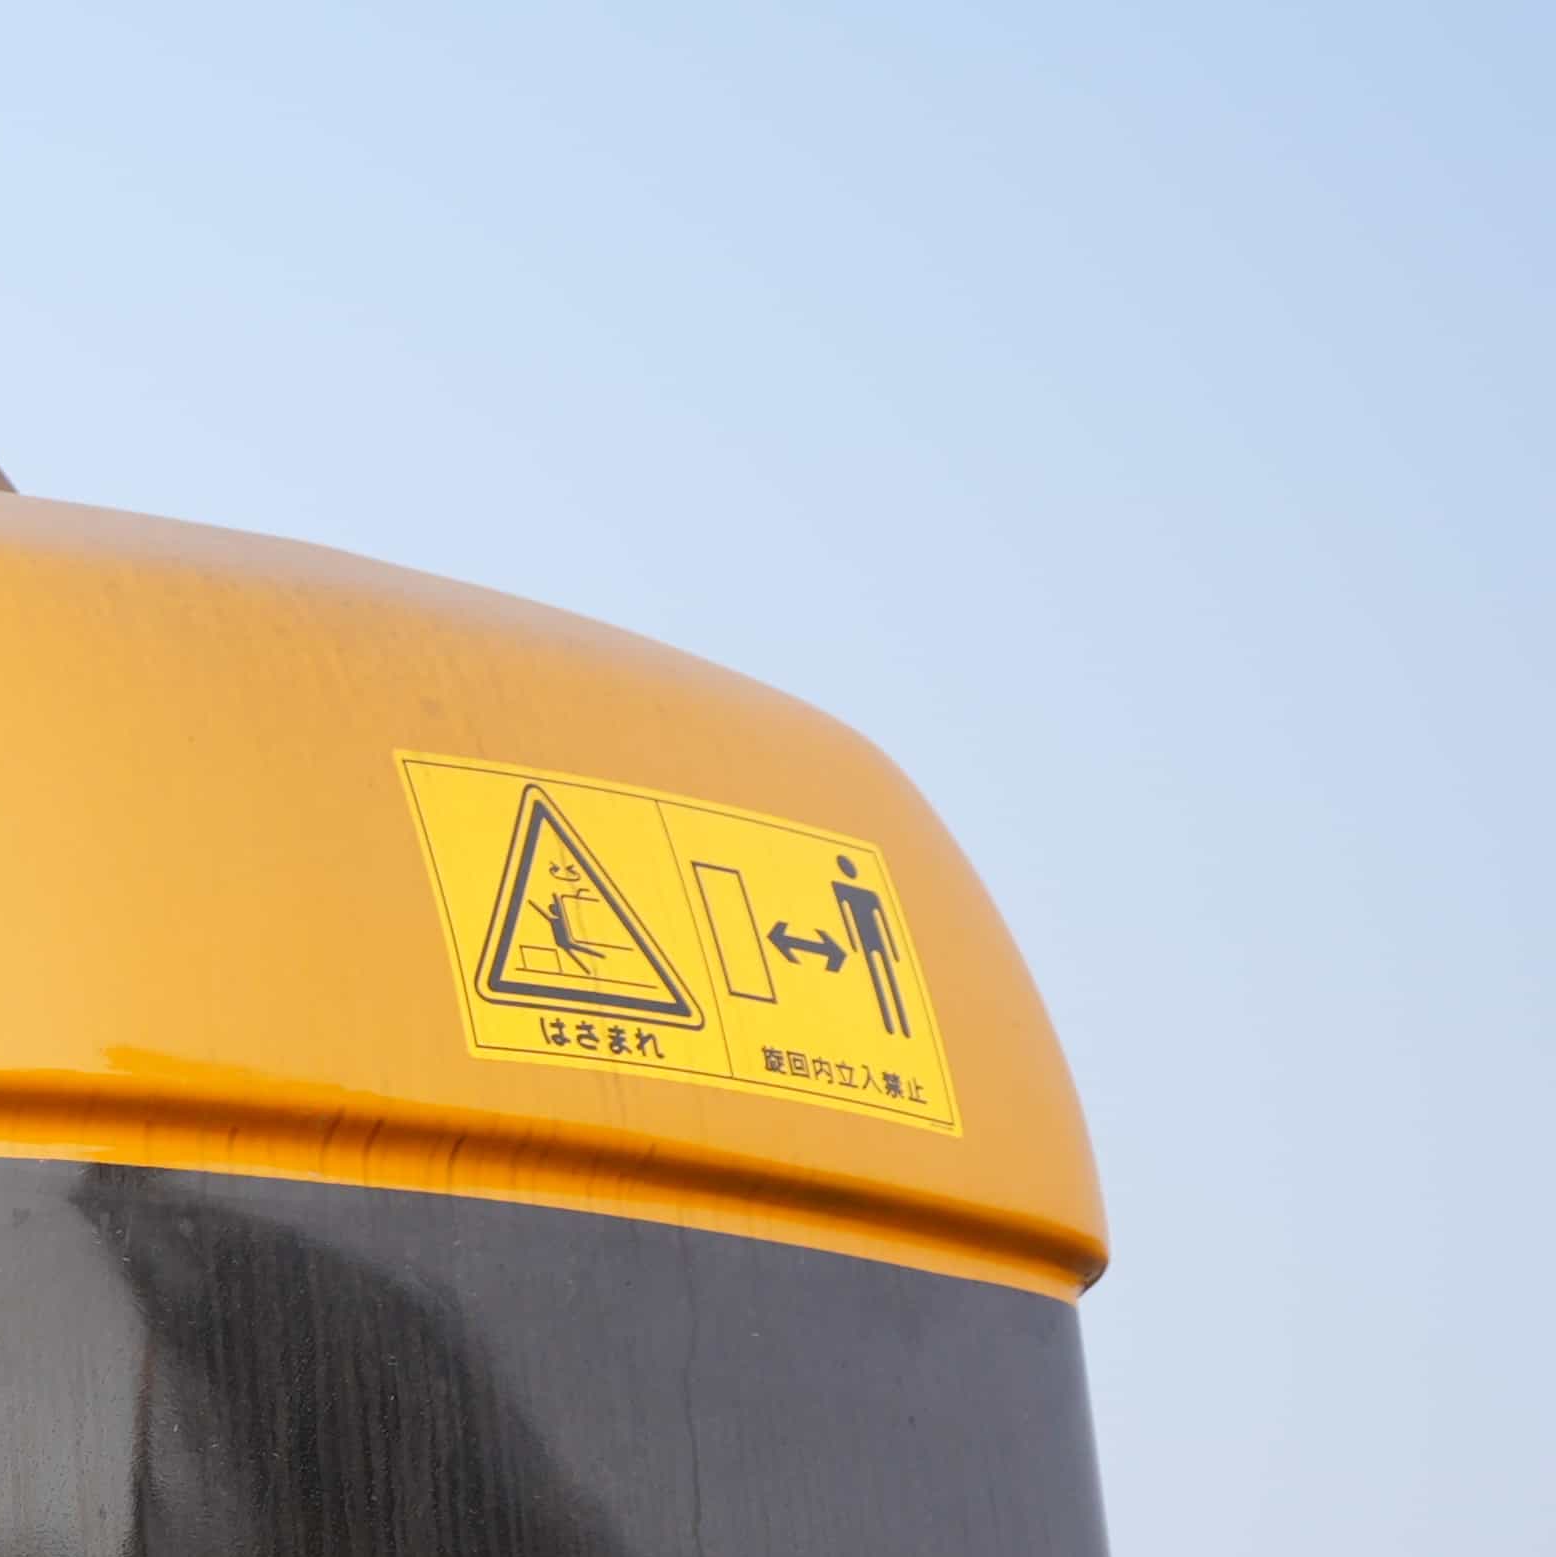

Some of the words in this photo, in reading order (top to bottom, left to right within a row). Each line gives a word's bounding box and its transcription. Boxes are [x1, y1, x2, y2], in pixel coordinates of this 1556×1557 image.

[538, 1016, 665, 1060] はさまれ
[761, 1045, 928, 1105] 旋回内立入禁止
